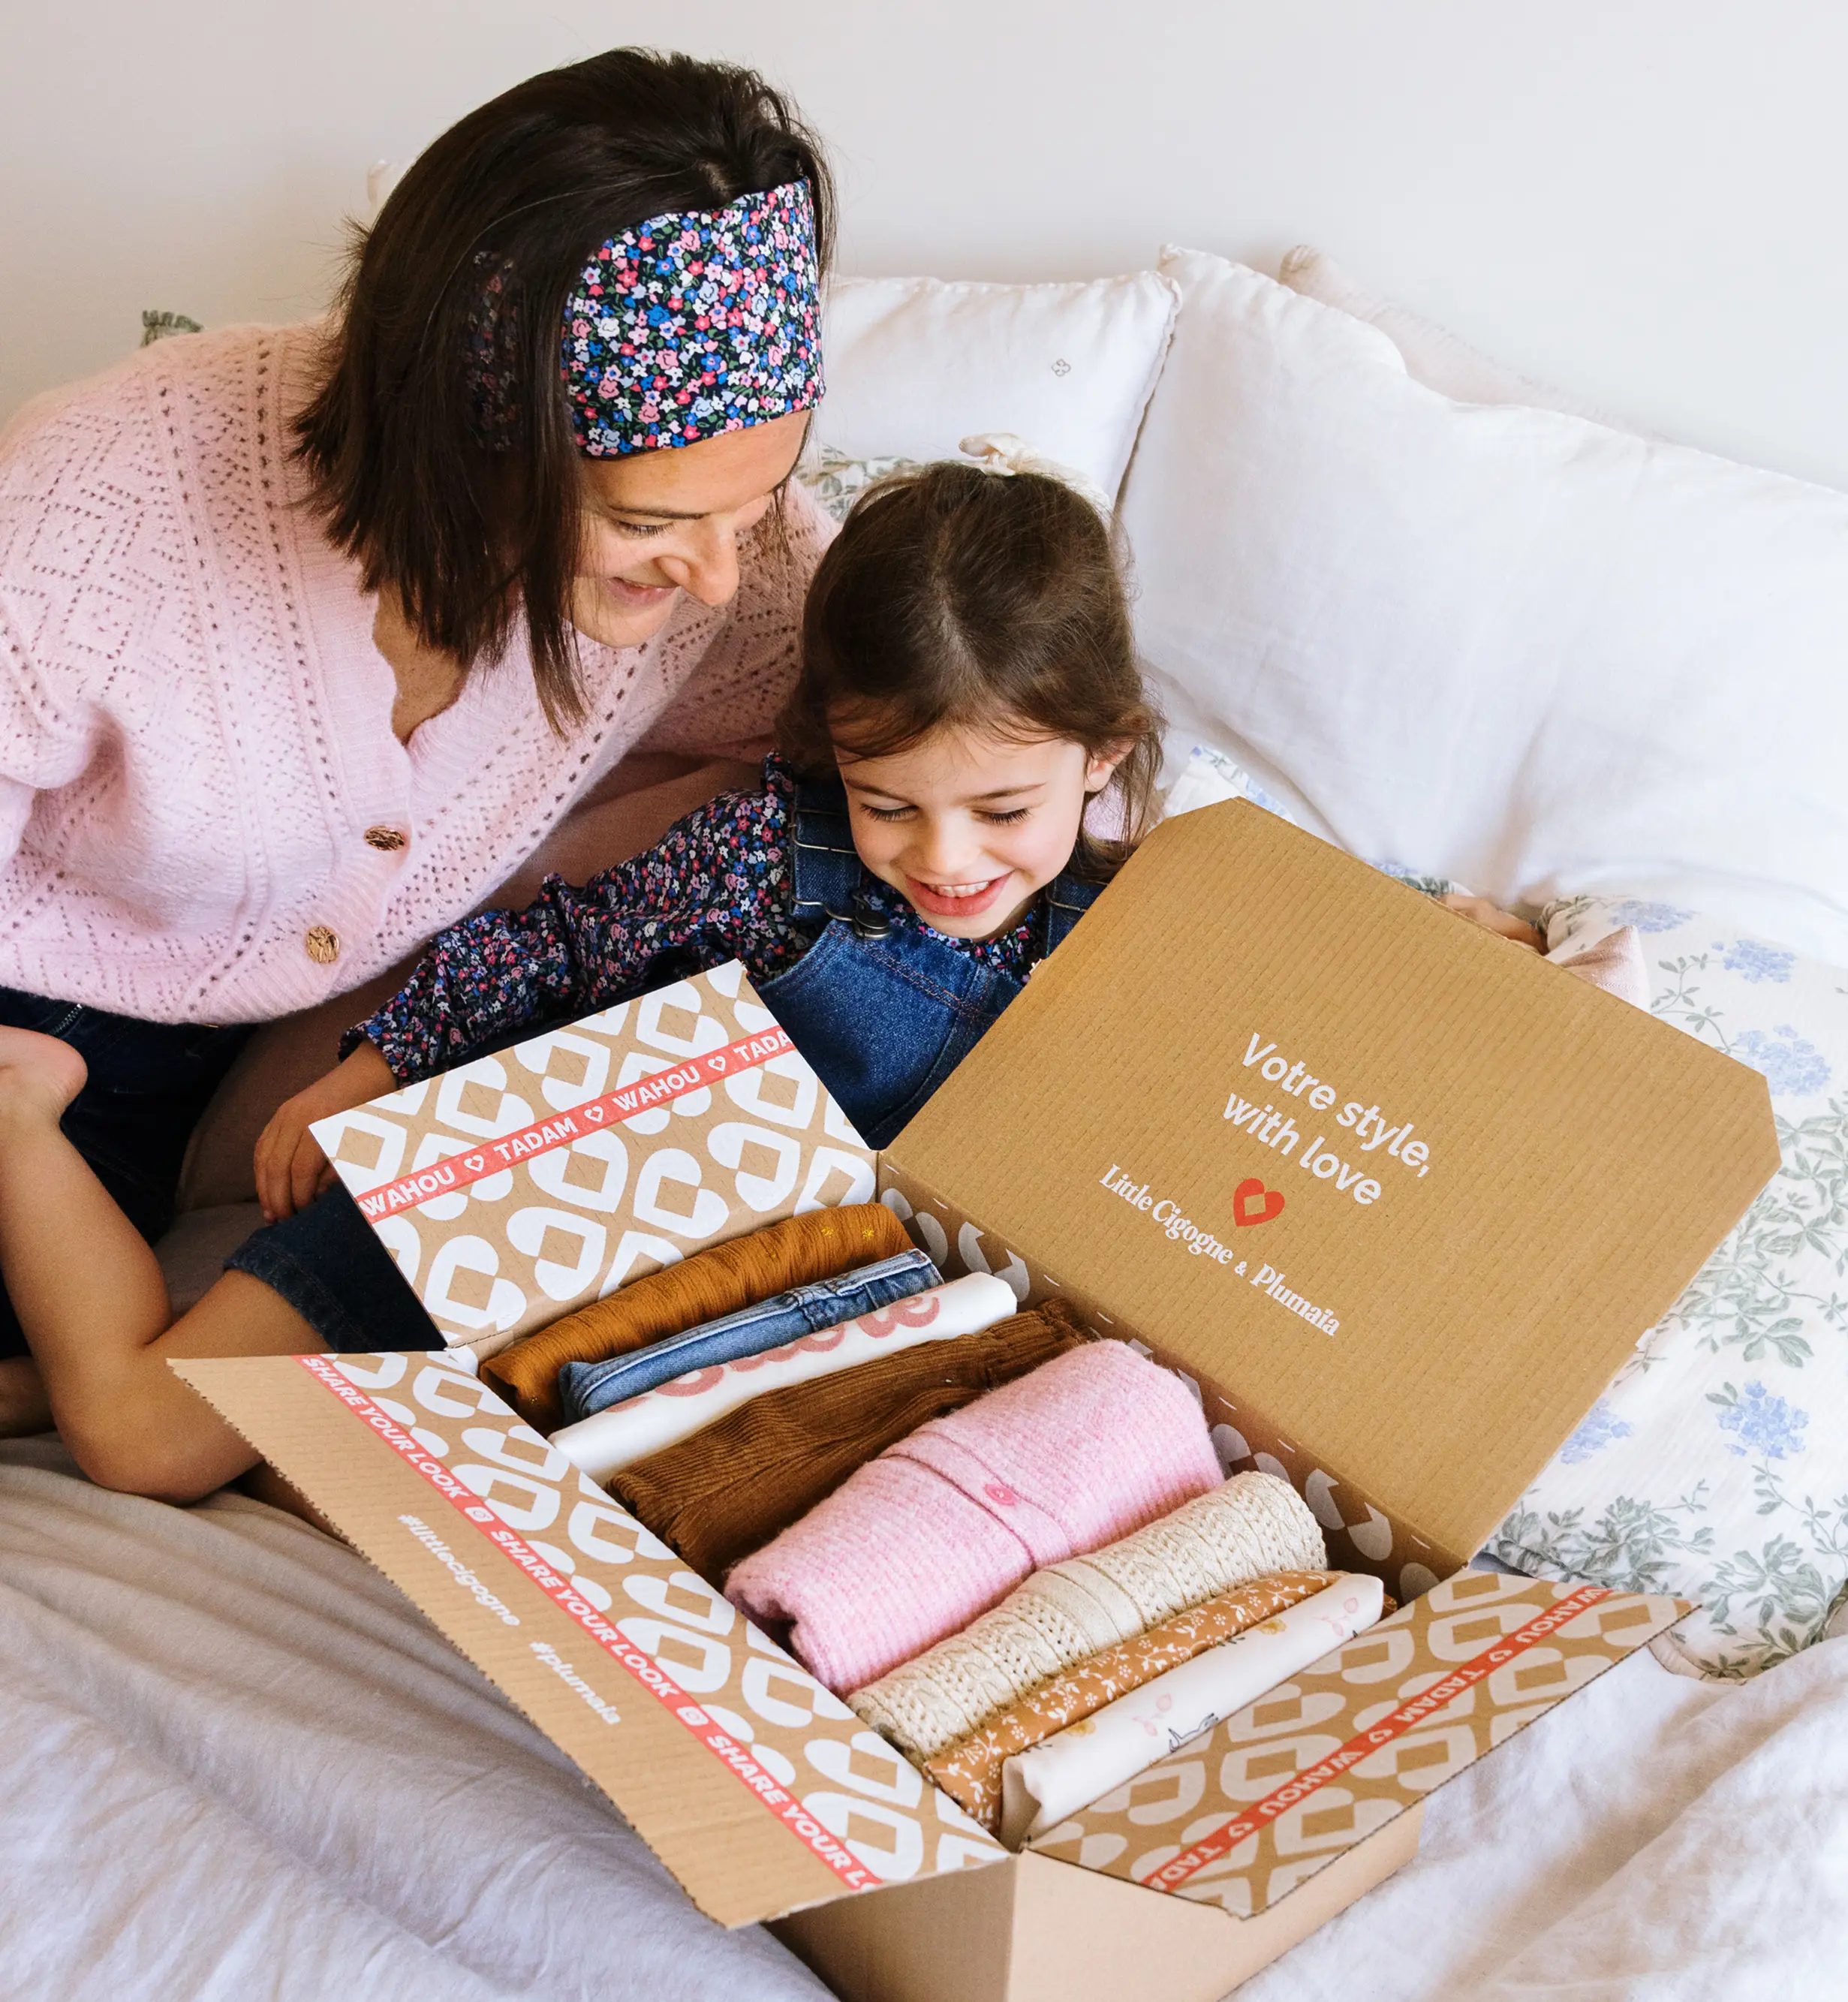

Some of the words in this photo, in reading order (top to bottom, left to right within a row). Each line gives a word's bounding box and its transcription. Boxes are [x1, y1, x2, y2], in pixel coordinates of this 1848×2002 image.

[359, 1166, 455, 1216] WAHOU
[493, 1117, 579, 1161] TADAM
[612, 1066, 700, 1111] WAHOU
[1223, 1094, 1299, 1155] with
[1299, 1136, 1381, 1204] love
[1242, 1033, 1335, 1109] Votre
[1336, 1103, 1429, 1177] style,
[1100, 1164, 1153, 1211] Little
[1153, 1200, 1233, 1264] Cigogne
[1234, 1261, 1247, 1277] &
[302, 1358, 369, 1405] SHARE
[360, 1407, 415, 1450] YOUR
[408, 1453, 470, 1498] LOOK
[491, 1530, 564, 1588] SHARE
[556, 1588, 619, 1642] YOUR
[612, 1643, 679, 1697] LOOK
[707, 1736, 790, 1804] SHARE
[783, 1805, 852, 1868] YOUR
[397, 1515, 520, 1626] #littlecigogne
[1515, 1588, 1607, 1643] WAHOU
[1393, 1669, 1485, 1722] TADAM
[1259, 1751, 1365, 1816] WAHOU
